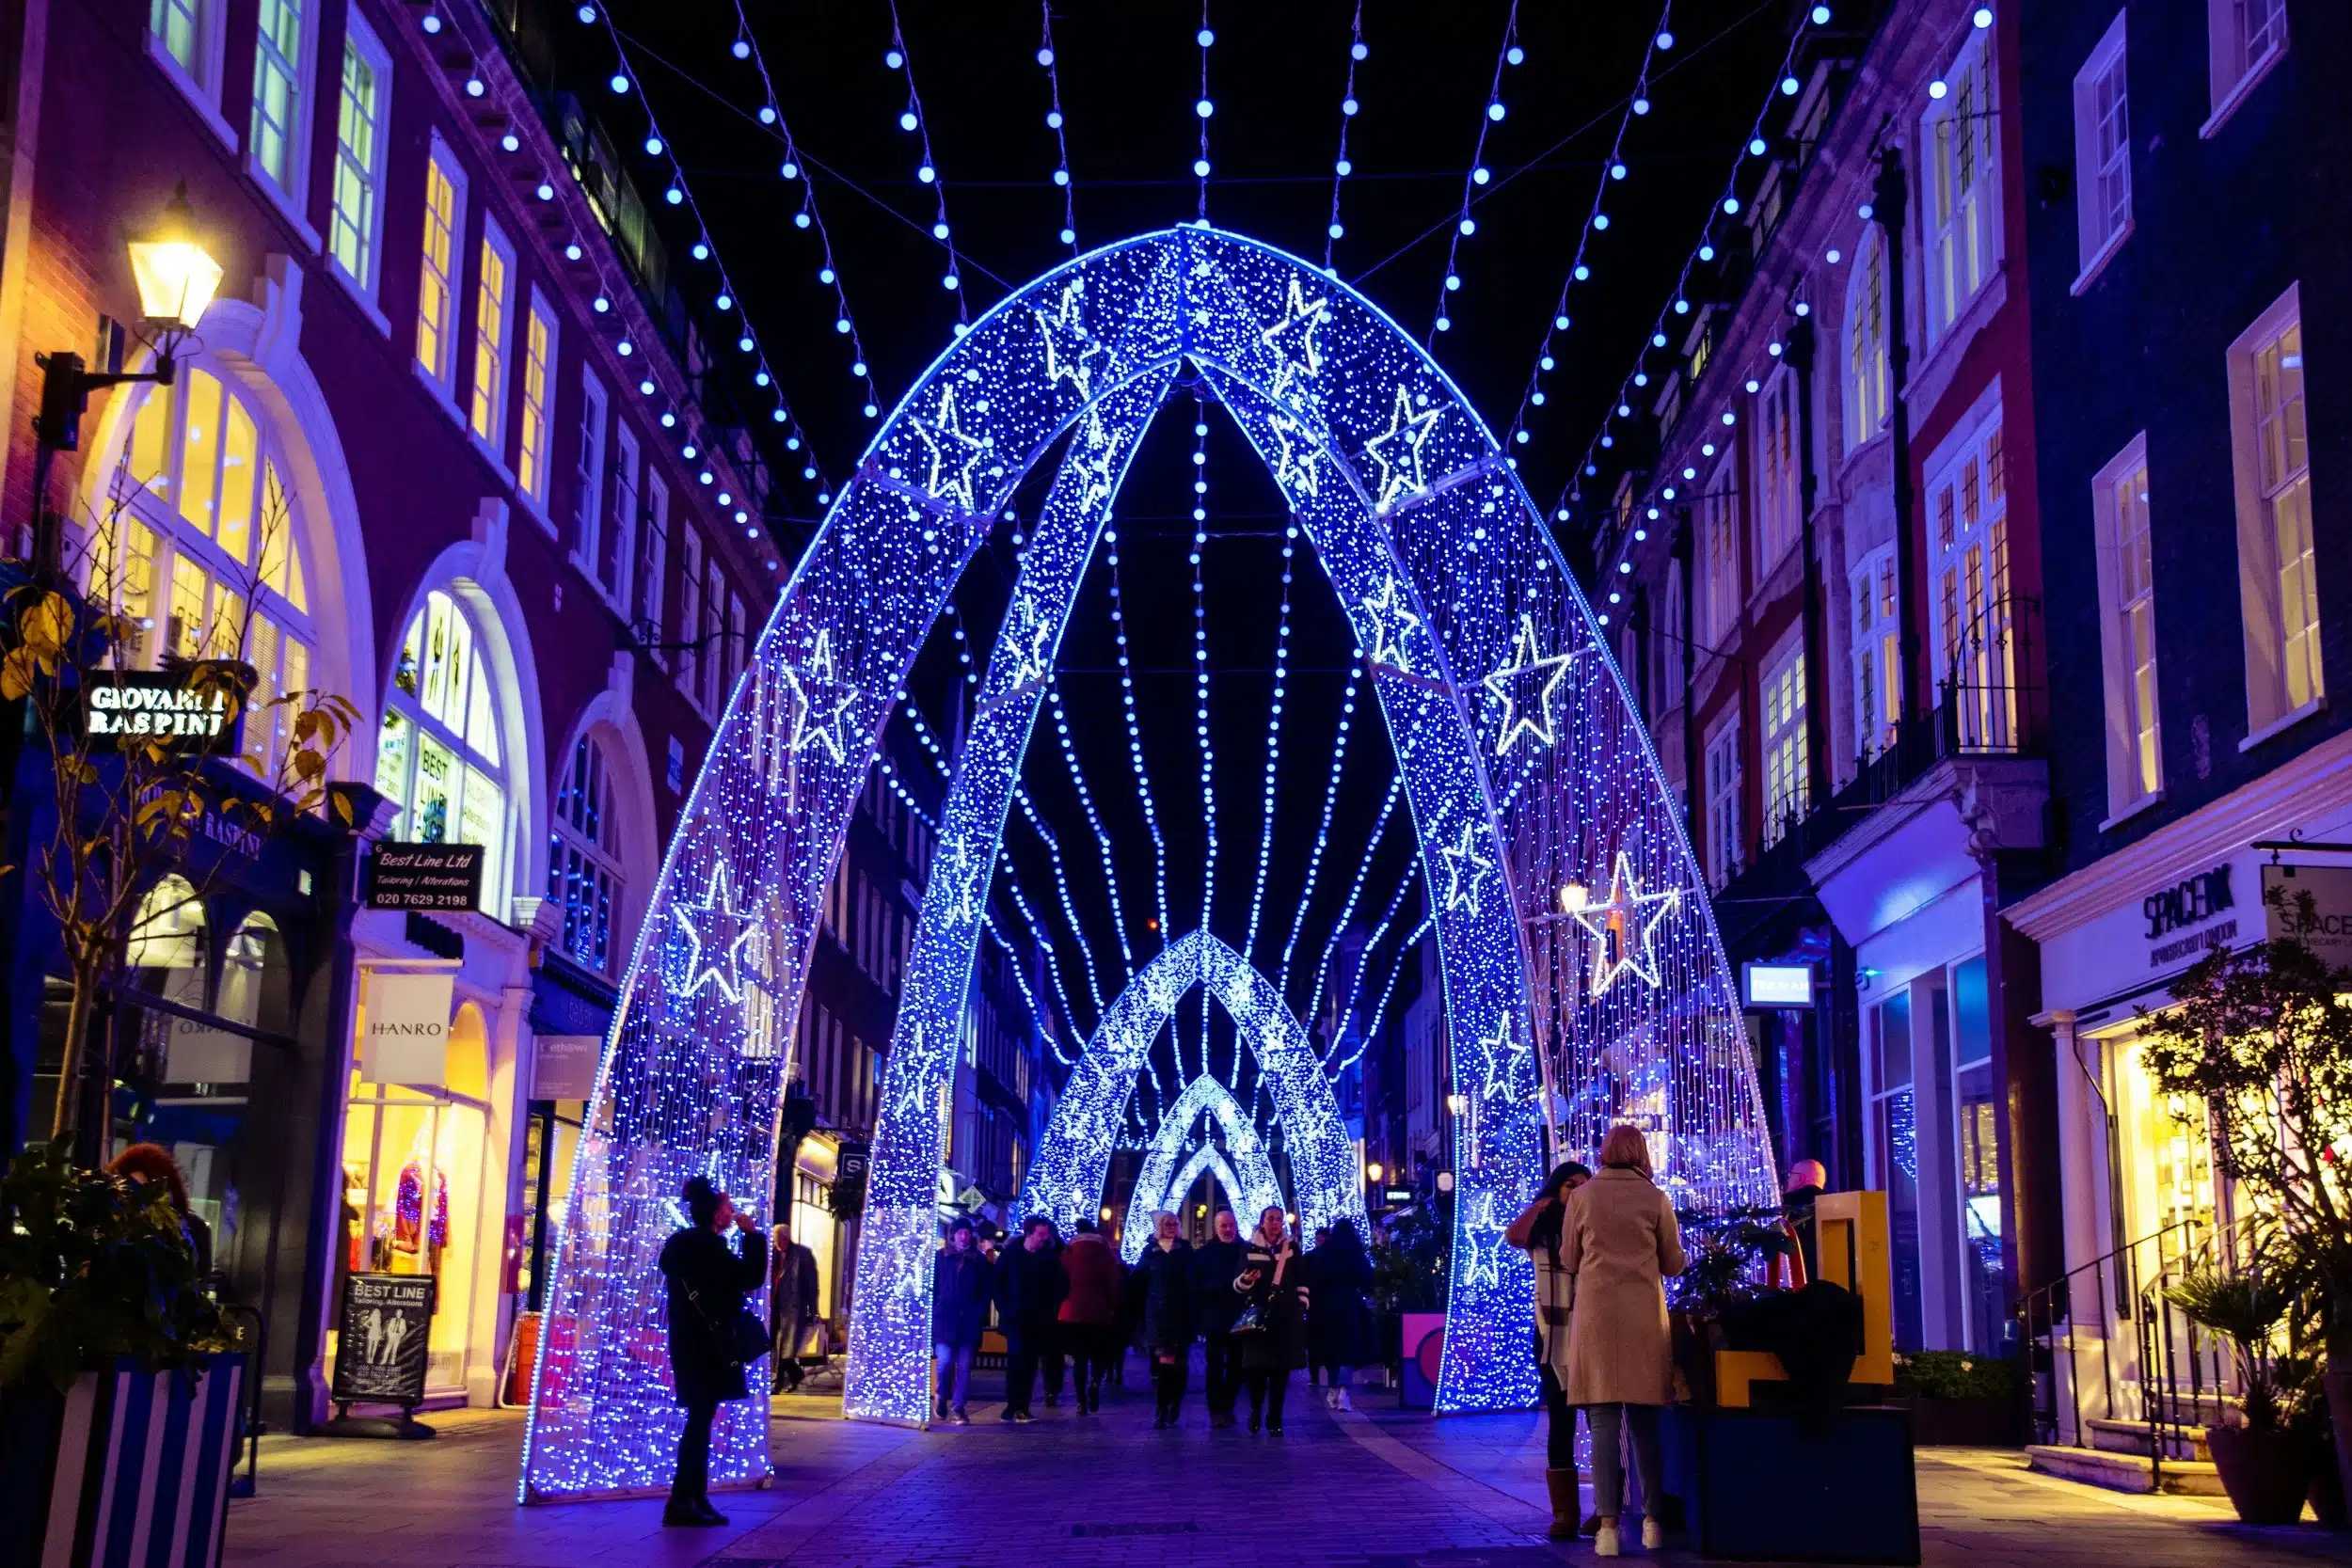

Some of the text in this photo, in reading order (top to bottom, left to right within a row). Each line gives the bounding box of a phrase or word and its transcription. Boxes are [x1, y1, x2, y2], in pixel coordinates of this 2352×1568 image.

[90, 687, 224, 711] GIOVANI
[88, 711, 224, 736] RASPINI
[423, 750, 448, 782] BEST
[375, 844, 383, 853] 6
[379, 852, 473, 868] Best Line Ltd
[377, 875, 414, 887] Tailoring
[421, 876, 470, 887] Alterations
[376, 894, 468, 906] 020 7629 2198
[372, 1022, 441, 1036] HANRO
[354, 1285, 426, 1299] BEST LINE
[387, 1299, 423, 1307] Alterations
